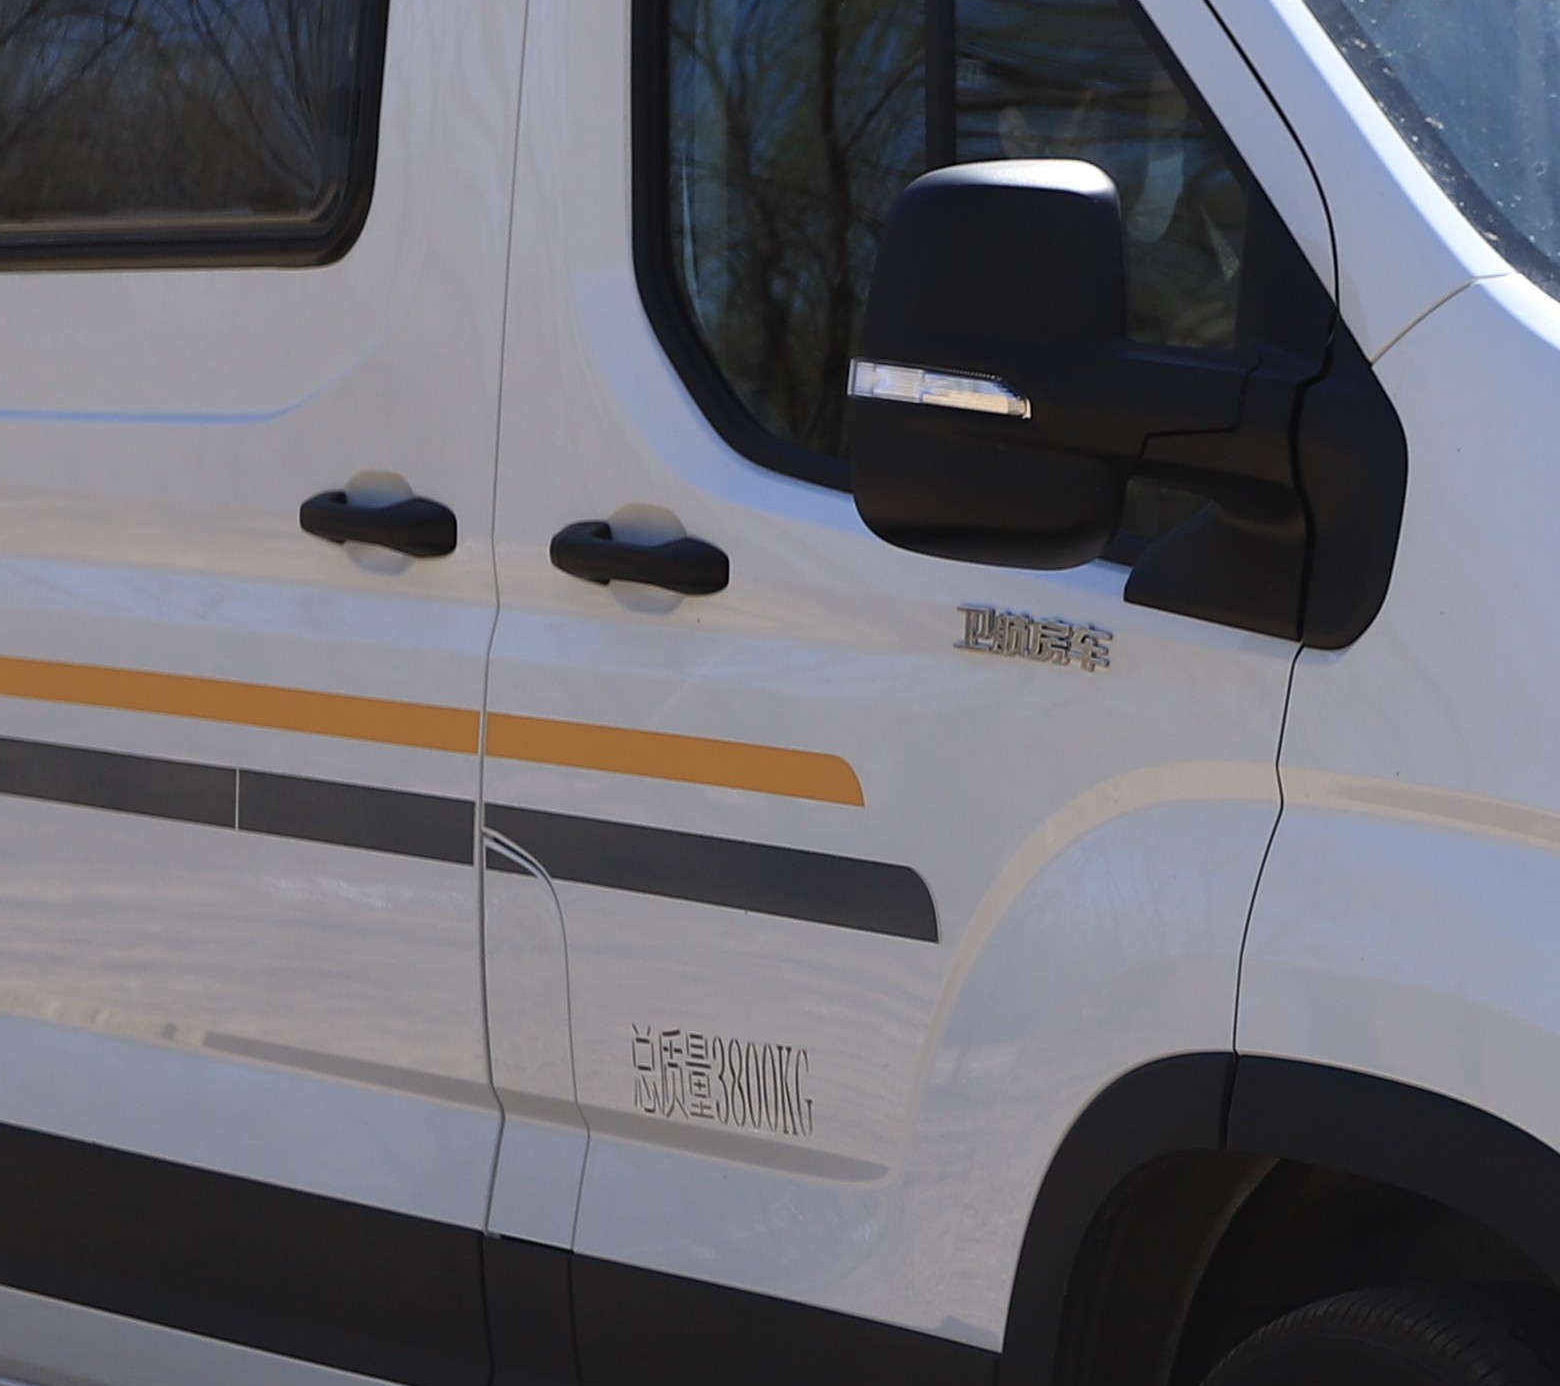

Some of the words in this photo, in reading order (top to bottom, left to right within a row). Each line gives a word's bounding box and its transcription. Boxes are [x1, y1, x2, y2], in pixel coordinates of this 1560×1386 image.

[953, 604, 1113, 672] 卫航房车
[632, 1023, 813, 1136] 总质量3800KG
